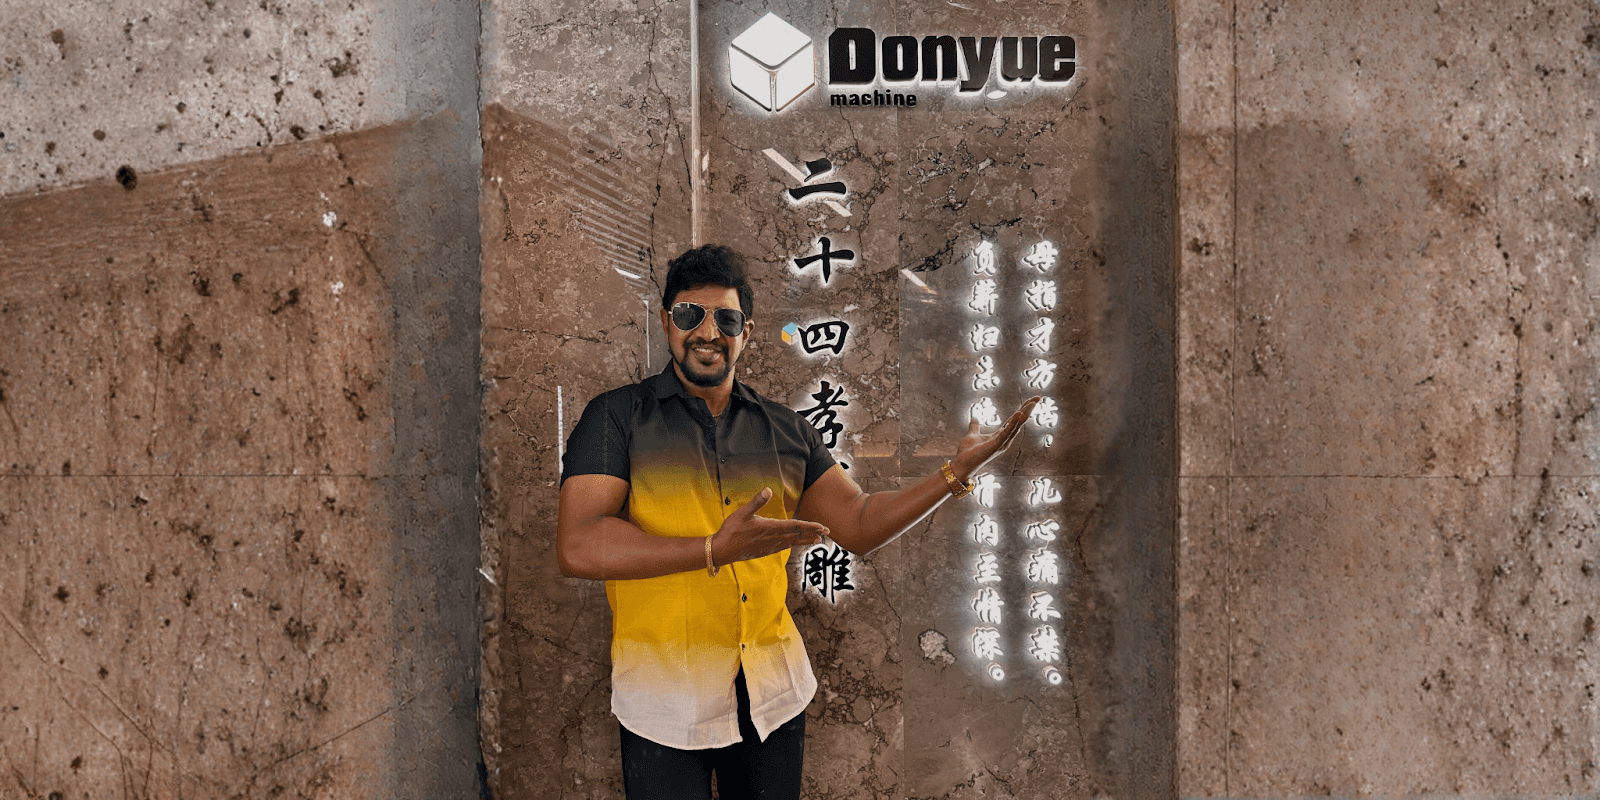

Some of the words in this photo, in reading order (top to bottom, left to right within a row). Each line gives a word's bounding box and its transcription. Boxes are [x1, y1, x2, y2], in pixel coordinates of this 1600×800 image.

[829, 28, 1076, 92] Donyue
[830, 89, 917, 107] machine
[788, 157, 856, 605] 二十四孝雕
